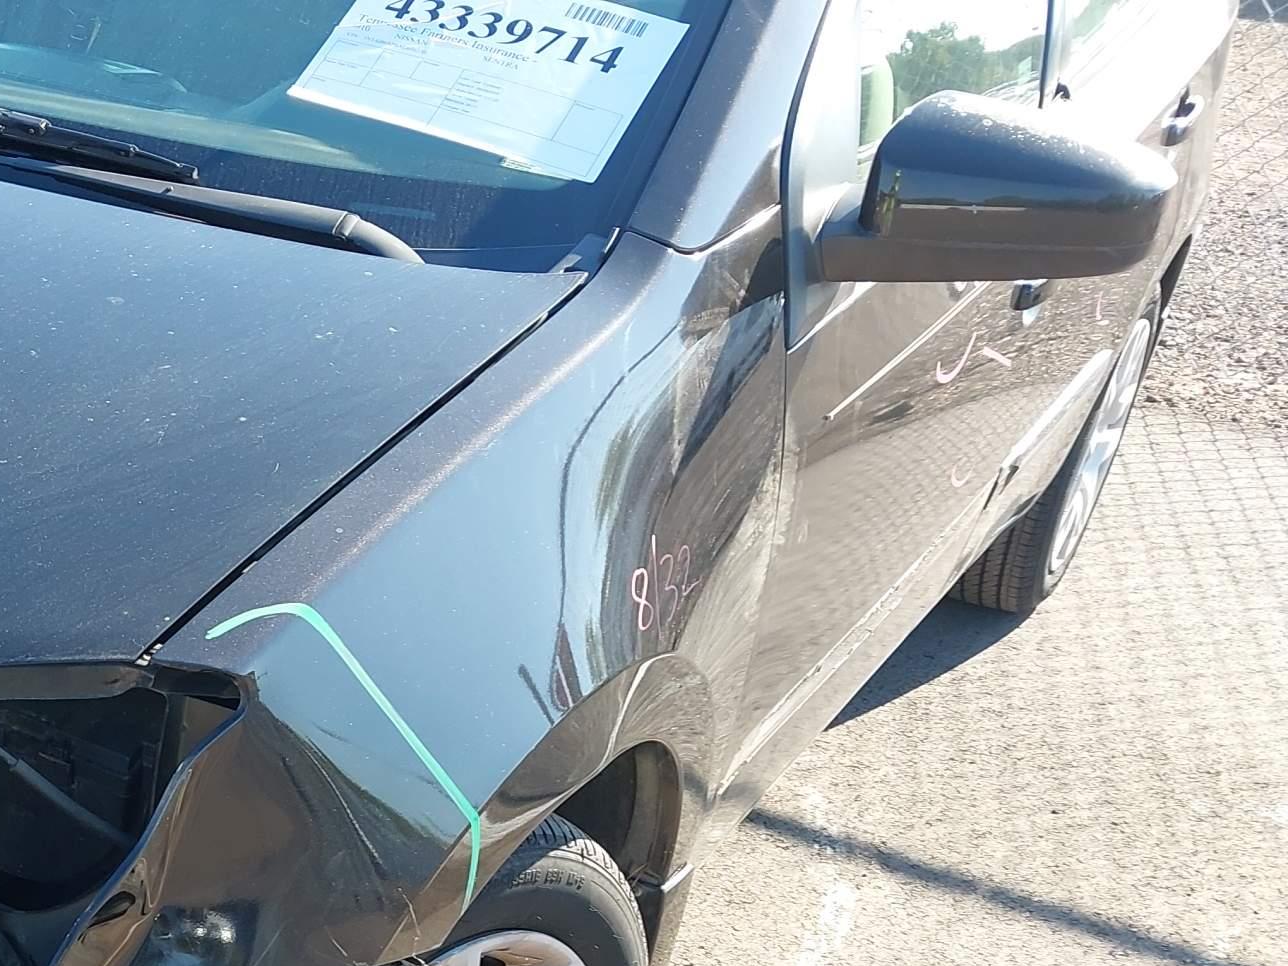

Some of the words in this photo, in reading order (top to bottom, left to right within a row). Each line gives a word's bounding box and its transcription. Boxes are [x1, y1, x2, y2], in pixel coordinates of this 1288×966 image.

[385, 0, 624, 74] 43339714
[471, 40, 530, 62] Insurance
[632, 534, 702, 640] 8/32
